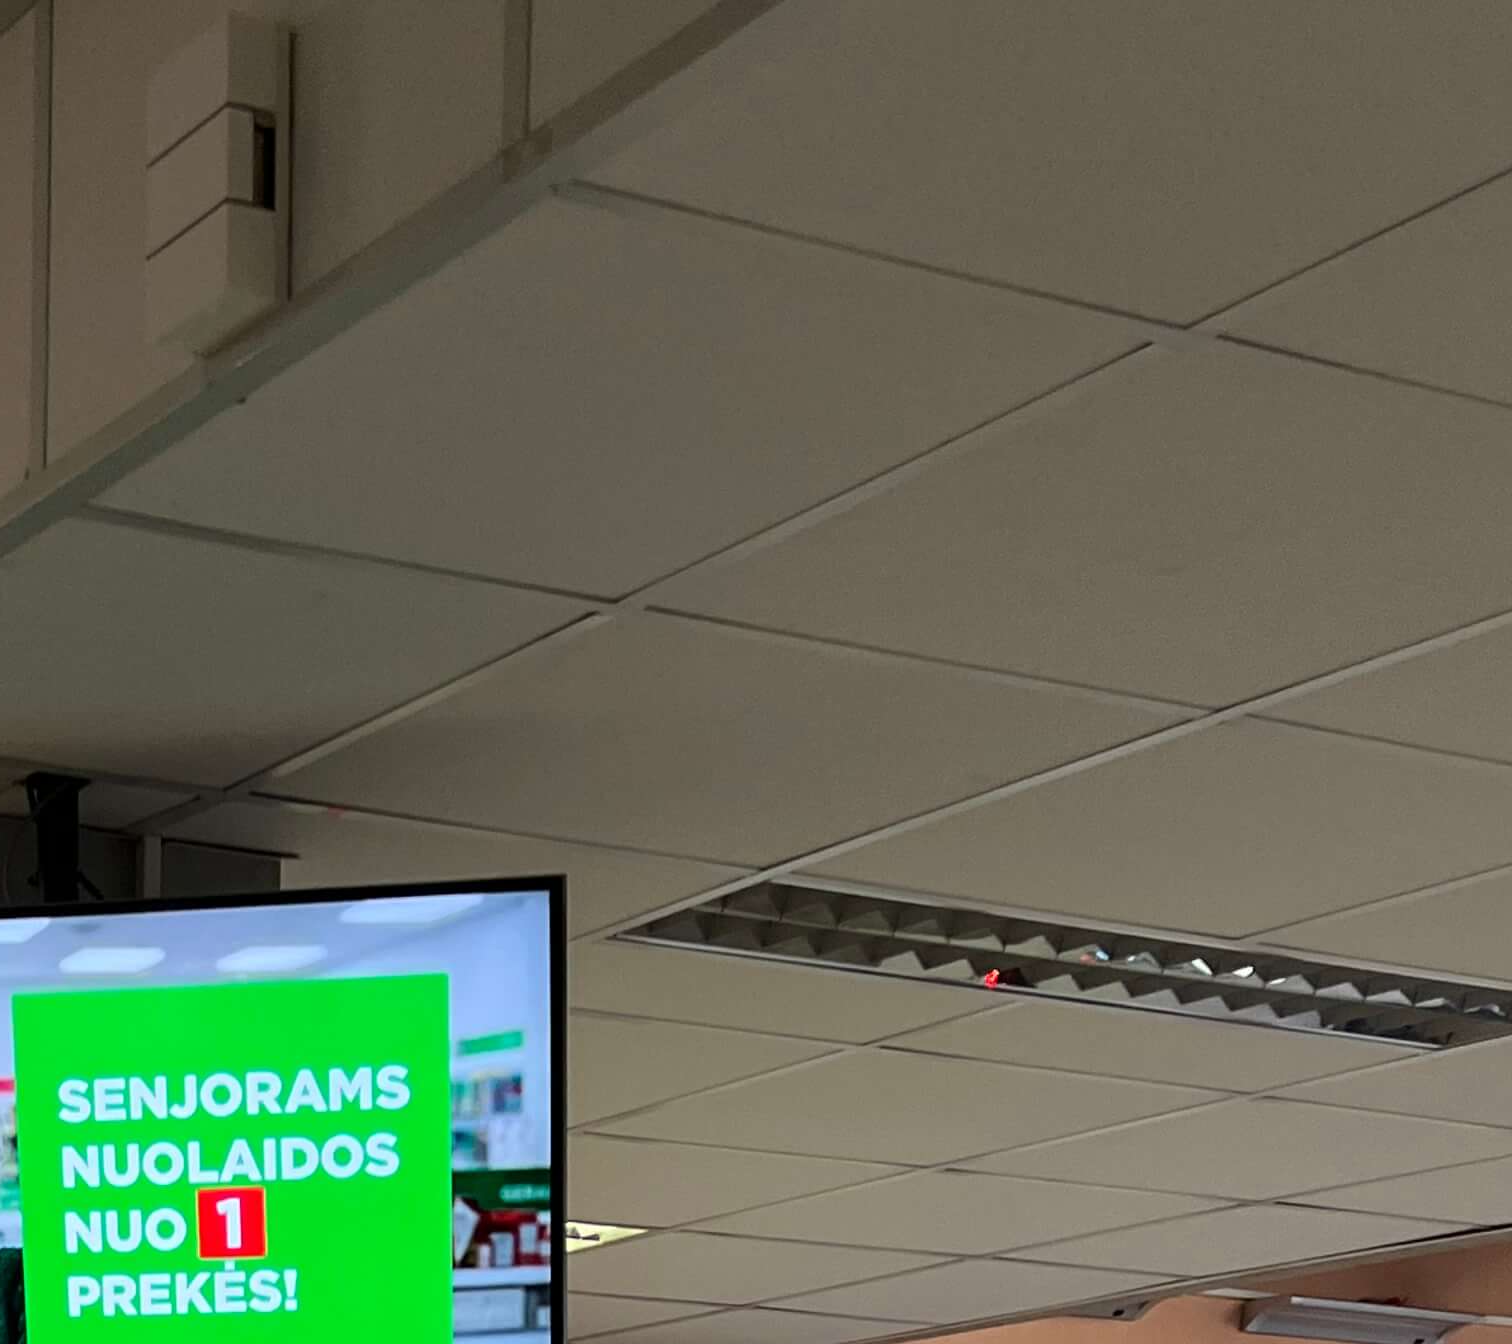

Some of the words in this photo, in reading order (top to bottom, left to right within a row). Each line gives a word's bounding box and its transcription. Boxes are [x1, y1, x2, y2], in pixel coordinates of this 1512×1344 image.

[58, 1064, 410, 1123] SENJORAMS
[61, 1132, 399, 1189] NUOLAIDOS
[64, 1207, 187, 1253] NUO
[215, 1197, 241, 1248] 1
[67, 1250, 297, 1317] PREKĖS!
